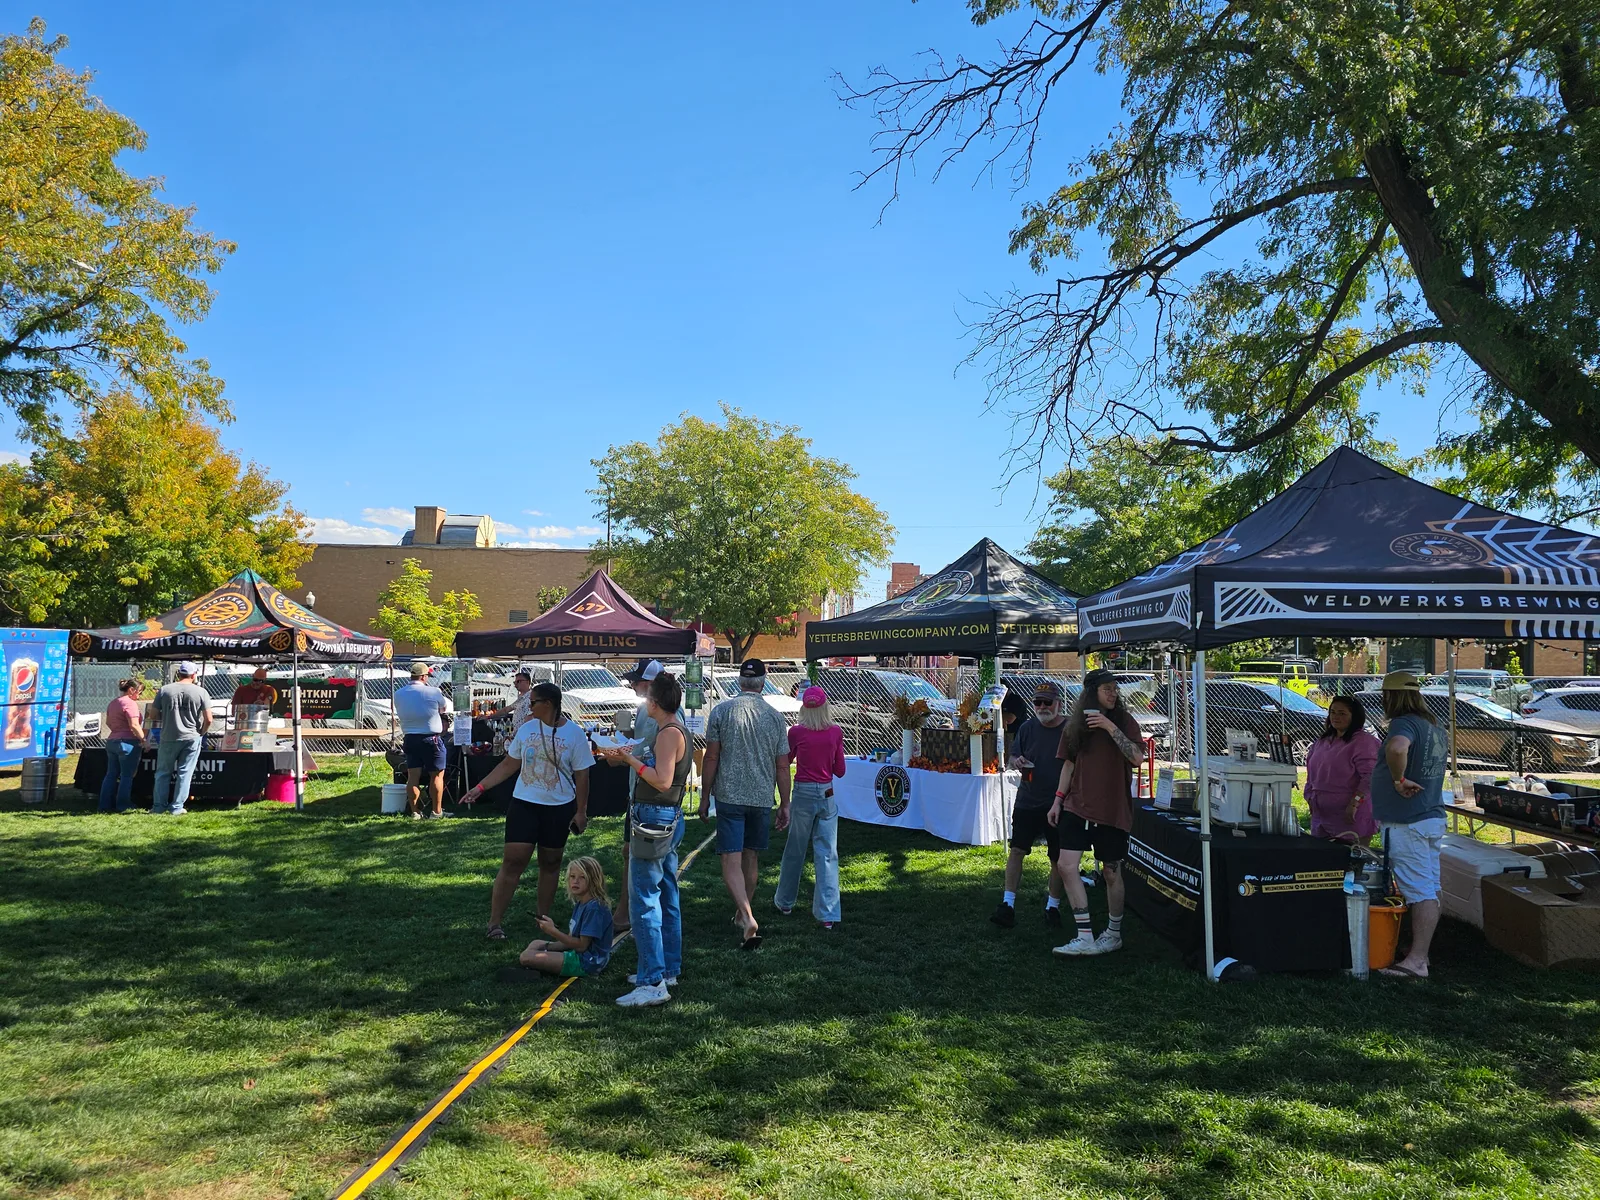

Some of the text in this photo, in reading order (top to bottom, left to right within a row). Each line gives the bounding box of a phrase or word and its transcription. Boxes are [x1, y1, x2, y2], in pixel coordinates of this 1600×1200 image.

[575, 602, 606, 612] 477
[1303, 594, 1600, 609] WELDWERKS BREWING
[1092, 601, 1165, 623] WELDWERKS BREWING CO
[808, 623, 990, 643] YETTERSBREWINGCOMPANY.COM
[1001, 623, 1078, 635] YETTERSBRE
[101, 634, 261, 651] TIGHTKNIT BREWING CO
[515, 634, 637, 649] 477 DISTILLING
[346, 643, 372, 655] BREWING
[372, 645, 382, 655] CO
[15, 692, 32, 700] pepsi
[281, 689, 339, 698] TIHTKNIT
[887, 778, 899, 798] Y
[881, 801, 905, 813] COMPANY
